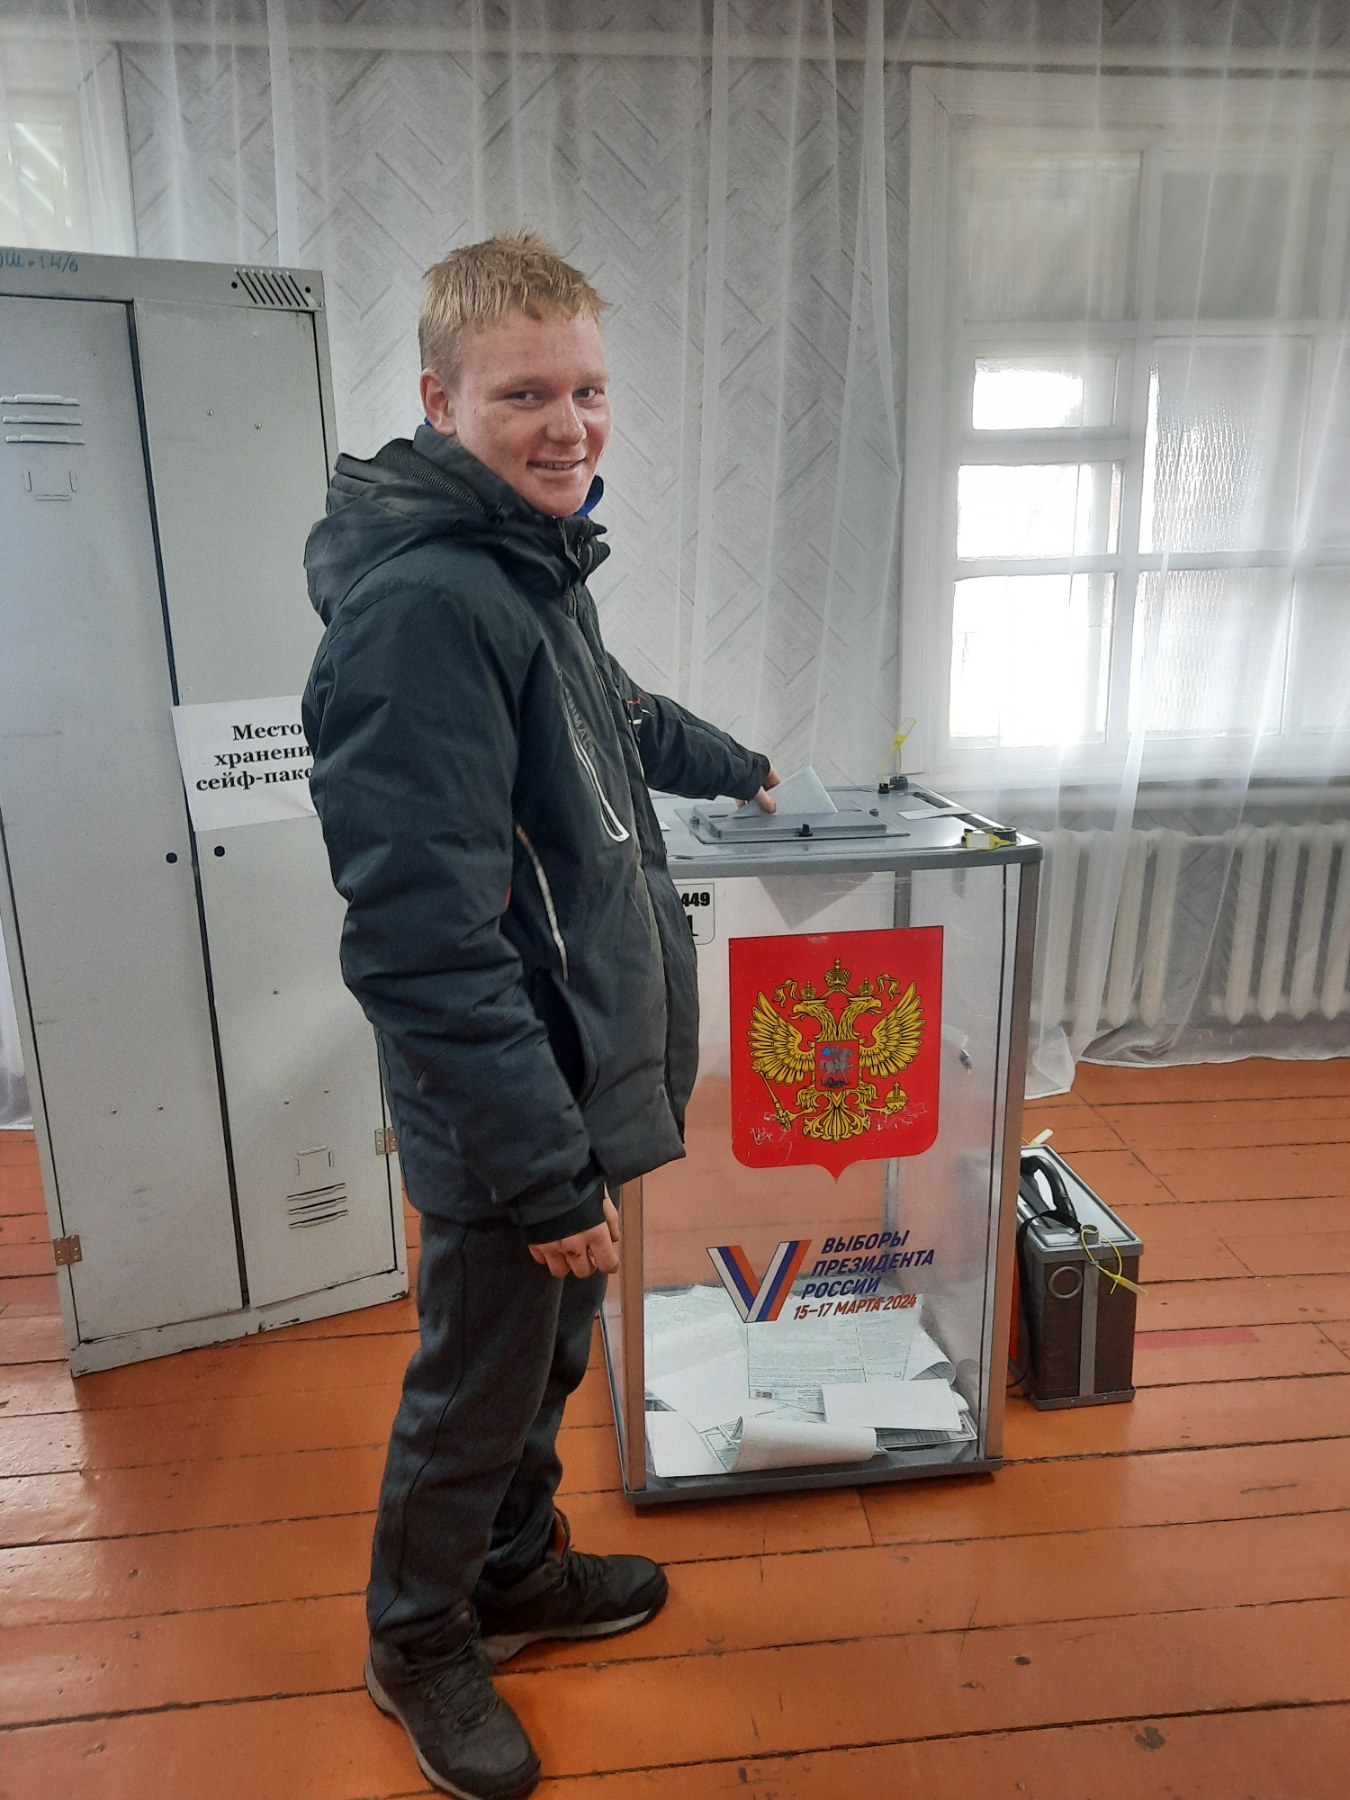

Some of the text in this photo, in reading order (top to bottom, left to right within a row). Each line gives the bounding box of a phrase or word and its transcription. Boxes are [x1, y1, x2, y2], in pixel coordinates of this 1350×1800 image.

[231, 723, 303, 741] Место
[214, 745, 312, 769] хранени
[196, 767, 313, 791] сейф-паке
[681, 891, 711, 907] 449
[821, 1230, 910, 1254] ВЫБОРЫ
[811, 1249, 935, 1277] ПРЕЗИДЕНТА
[800, 1277, 882, 1300] РОССИИ
[832, 1298, 883, 1316] МАРТА
[882, 1293, 918, 1311] 2024
